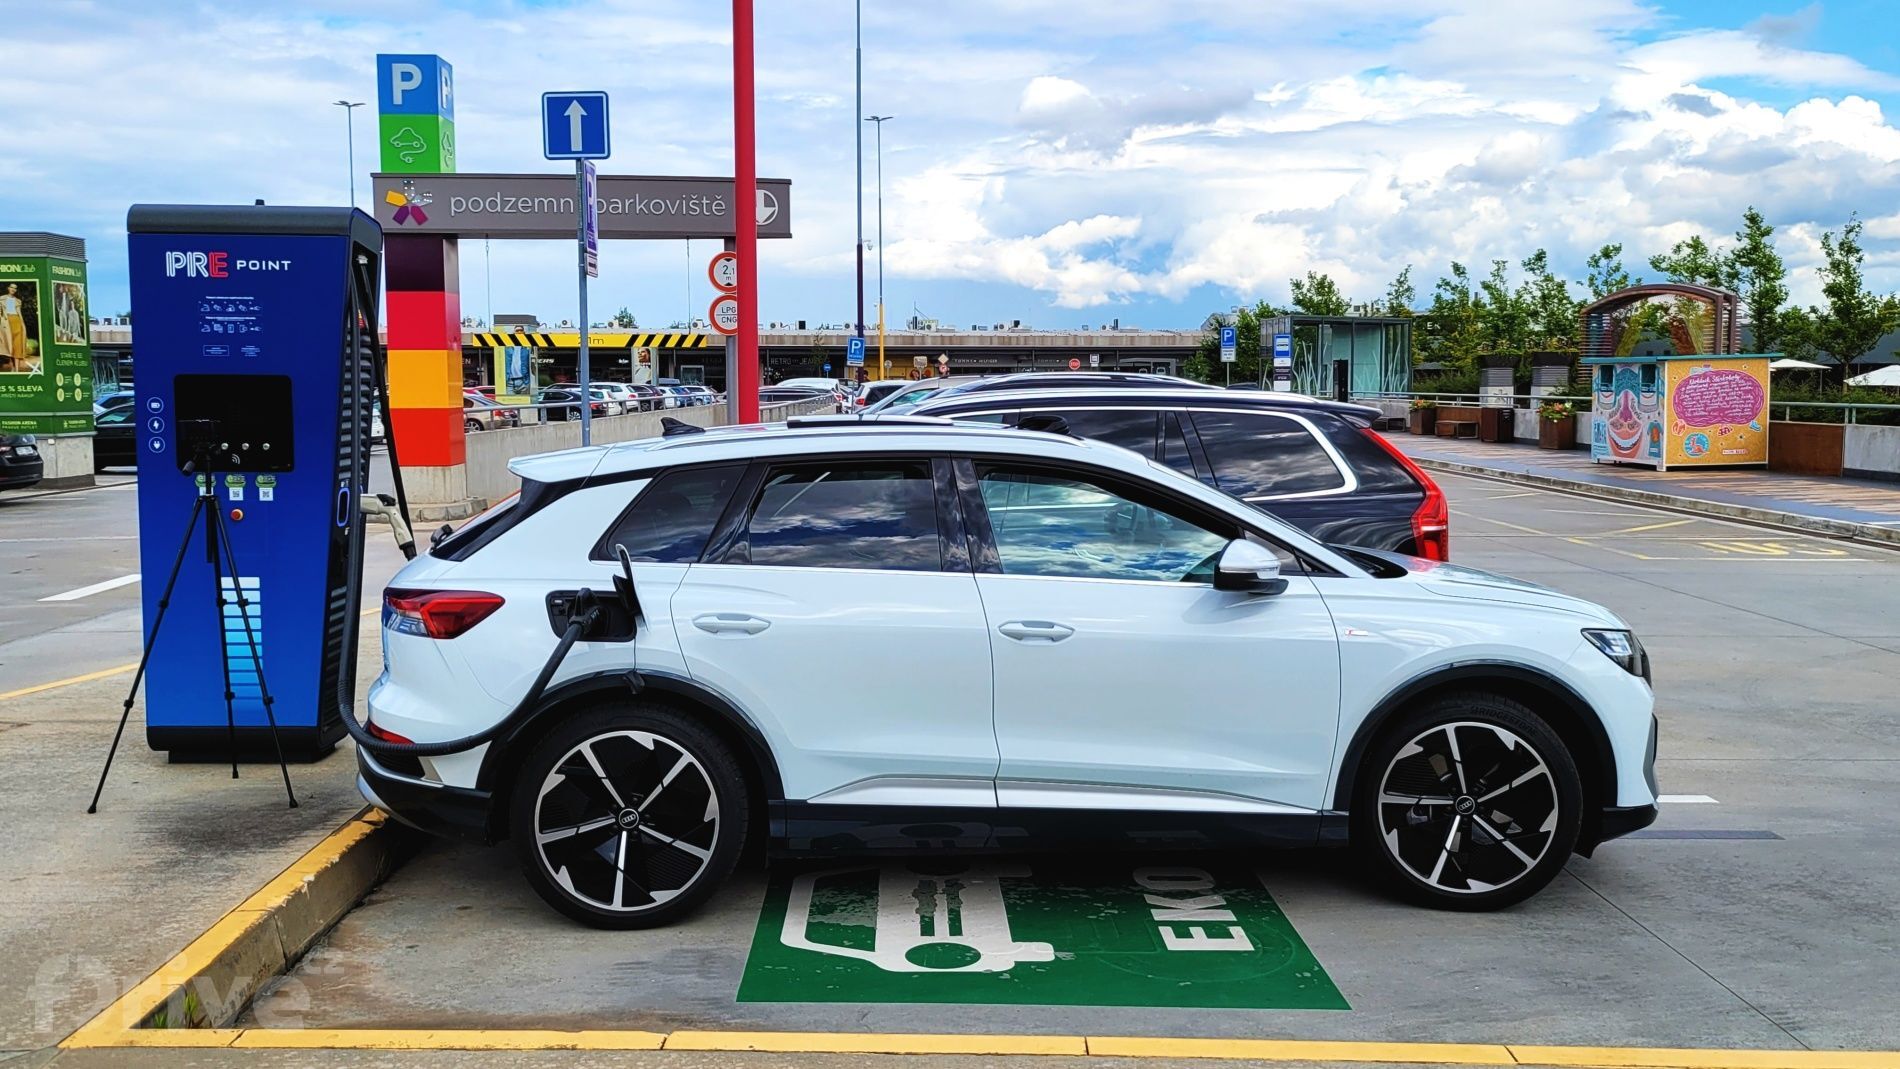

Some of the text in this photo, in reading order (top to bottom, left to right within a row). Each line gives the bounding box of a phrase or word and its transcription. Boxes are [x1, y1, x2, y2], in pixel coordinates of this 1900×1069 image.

[391, 63, 423, 105] P
[440, 66, 452, 110] P
[450, 191, 576, 216] podzemn
[165, 251, 291, 278] PRE POINT
[721, 306, 737, 314] LPG
[721, 316, 737, 324] CNG
[577, 336, 604, 345] 1m
[1223, 329, 1233, 342] P
[851, 340, 861, 354] P
[1132, 867, 1256, 951] EKO
